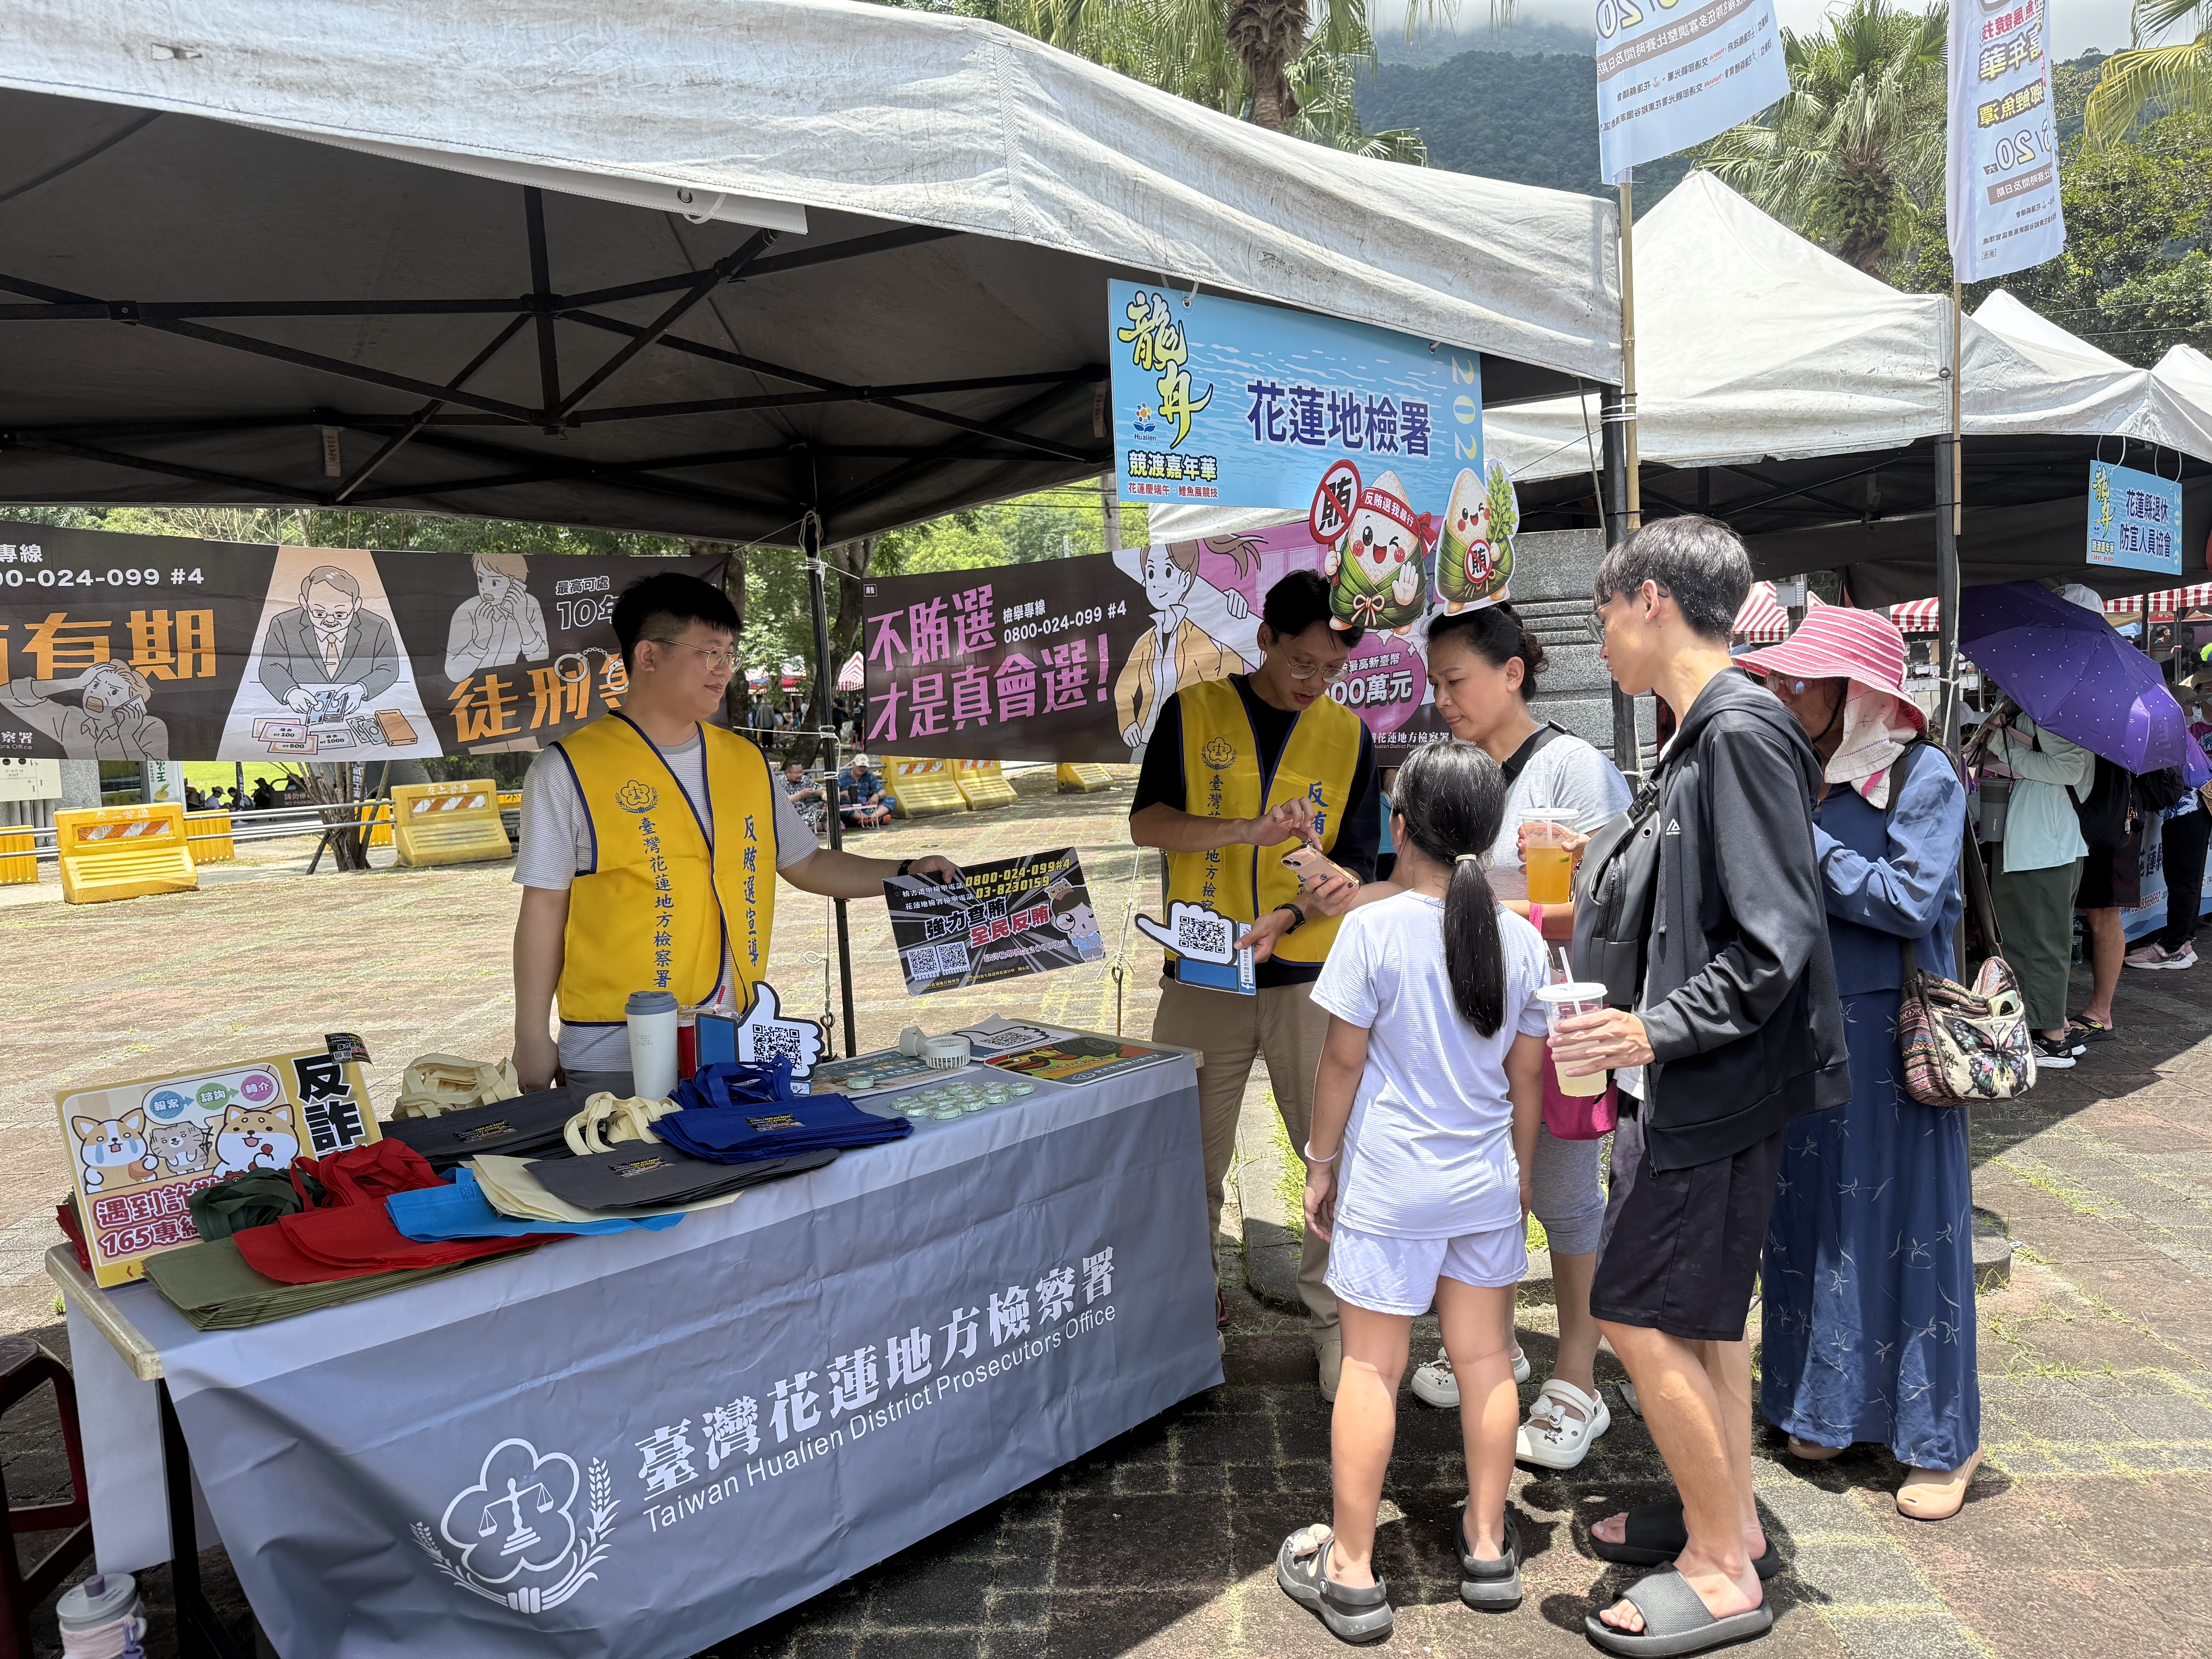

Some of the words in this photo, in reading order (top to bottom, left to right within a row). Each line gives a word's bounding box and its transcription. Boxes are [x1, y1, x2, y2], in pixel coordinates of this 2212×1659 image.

[1247, 380, 1431, 457] 花蓮地檢署
[1128, 450, 1217, 482] 競渡嘉年華
[1364, 490, 1414, 527] 反賄選我最行
[2126, 489, 2168, 524] 花蓮縣退休
[2120, 523, 2171, 558] 防宣人員協會
[0, 568, 160, 587] 0-024-099
[170, 568, 204, 585] #4
[556, 576, 609, 595] 最高可處
[866, 586, 875, 594] 廣告
[867, 584, 997, 672] 不賄選
[1003, 599, 1046, 625] 檢舉專線
[1004, 606, 1103, 644] 0800-024-099
[1108, 600, 1127, 620] #4
[0, 609, 216, 684] 有期
[1324, 670, 1413, 706] 00萬元
[965, 858, 1070, 888] 0800-024-099#4
[975, 876, 1050, 899] 03-8230159
[639, 817, 674, 988] 臺灣花蓮地方檢察署
[925, 896, 1007, 940] 強力查賄
[970, 904, 1050, 948] 全民反賄
[153, 1098, 180, 1112] 報案
[200, 1089, 227, 1104] 諮詢
[245, 1081, 271, 1095] 轉介
[291, 1054, 367, 1161] 反詐
[96, 1178, 223, 1228] 遇到詐
[635, 1246, 1115, 1503] 臺灣花蓮地方檢察署
[643, 1477, 739, 1533] Taiwan
[749, 1430, 843, 1488] Hualien
[851, 1386, 934, 1440] District
[936, 1329, 1062, 1402] Prosecutors
[1065, 1304, 1117, 1340] Office
